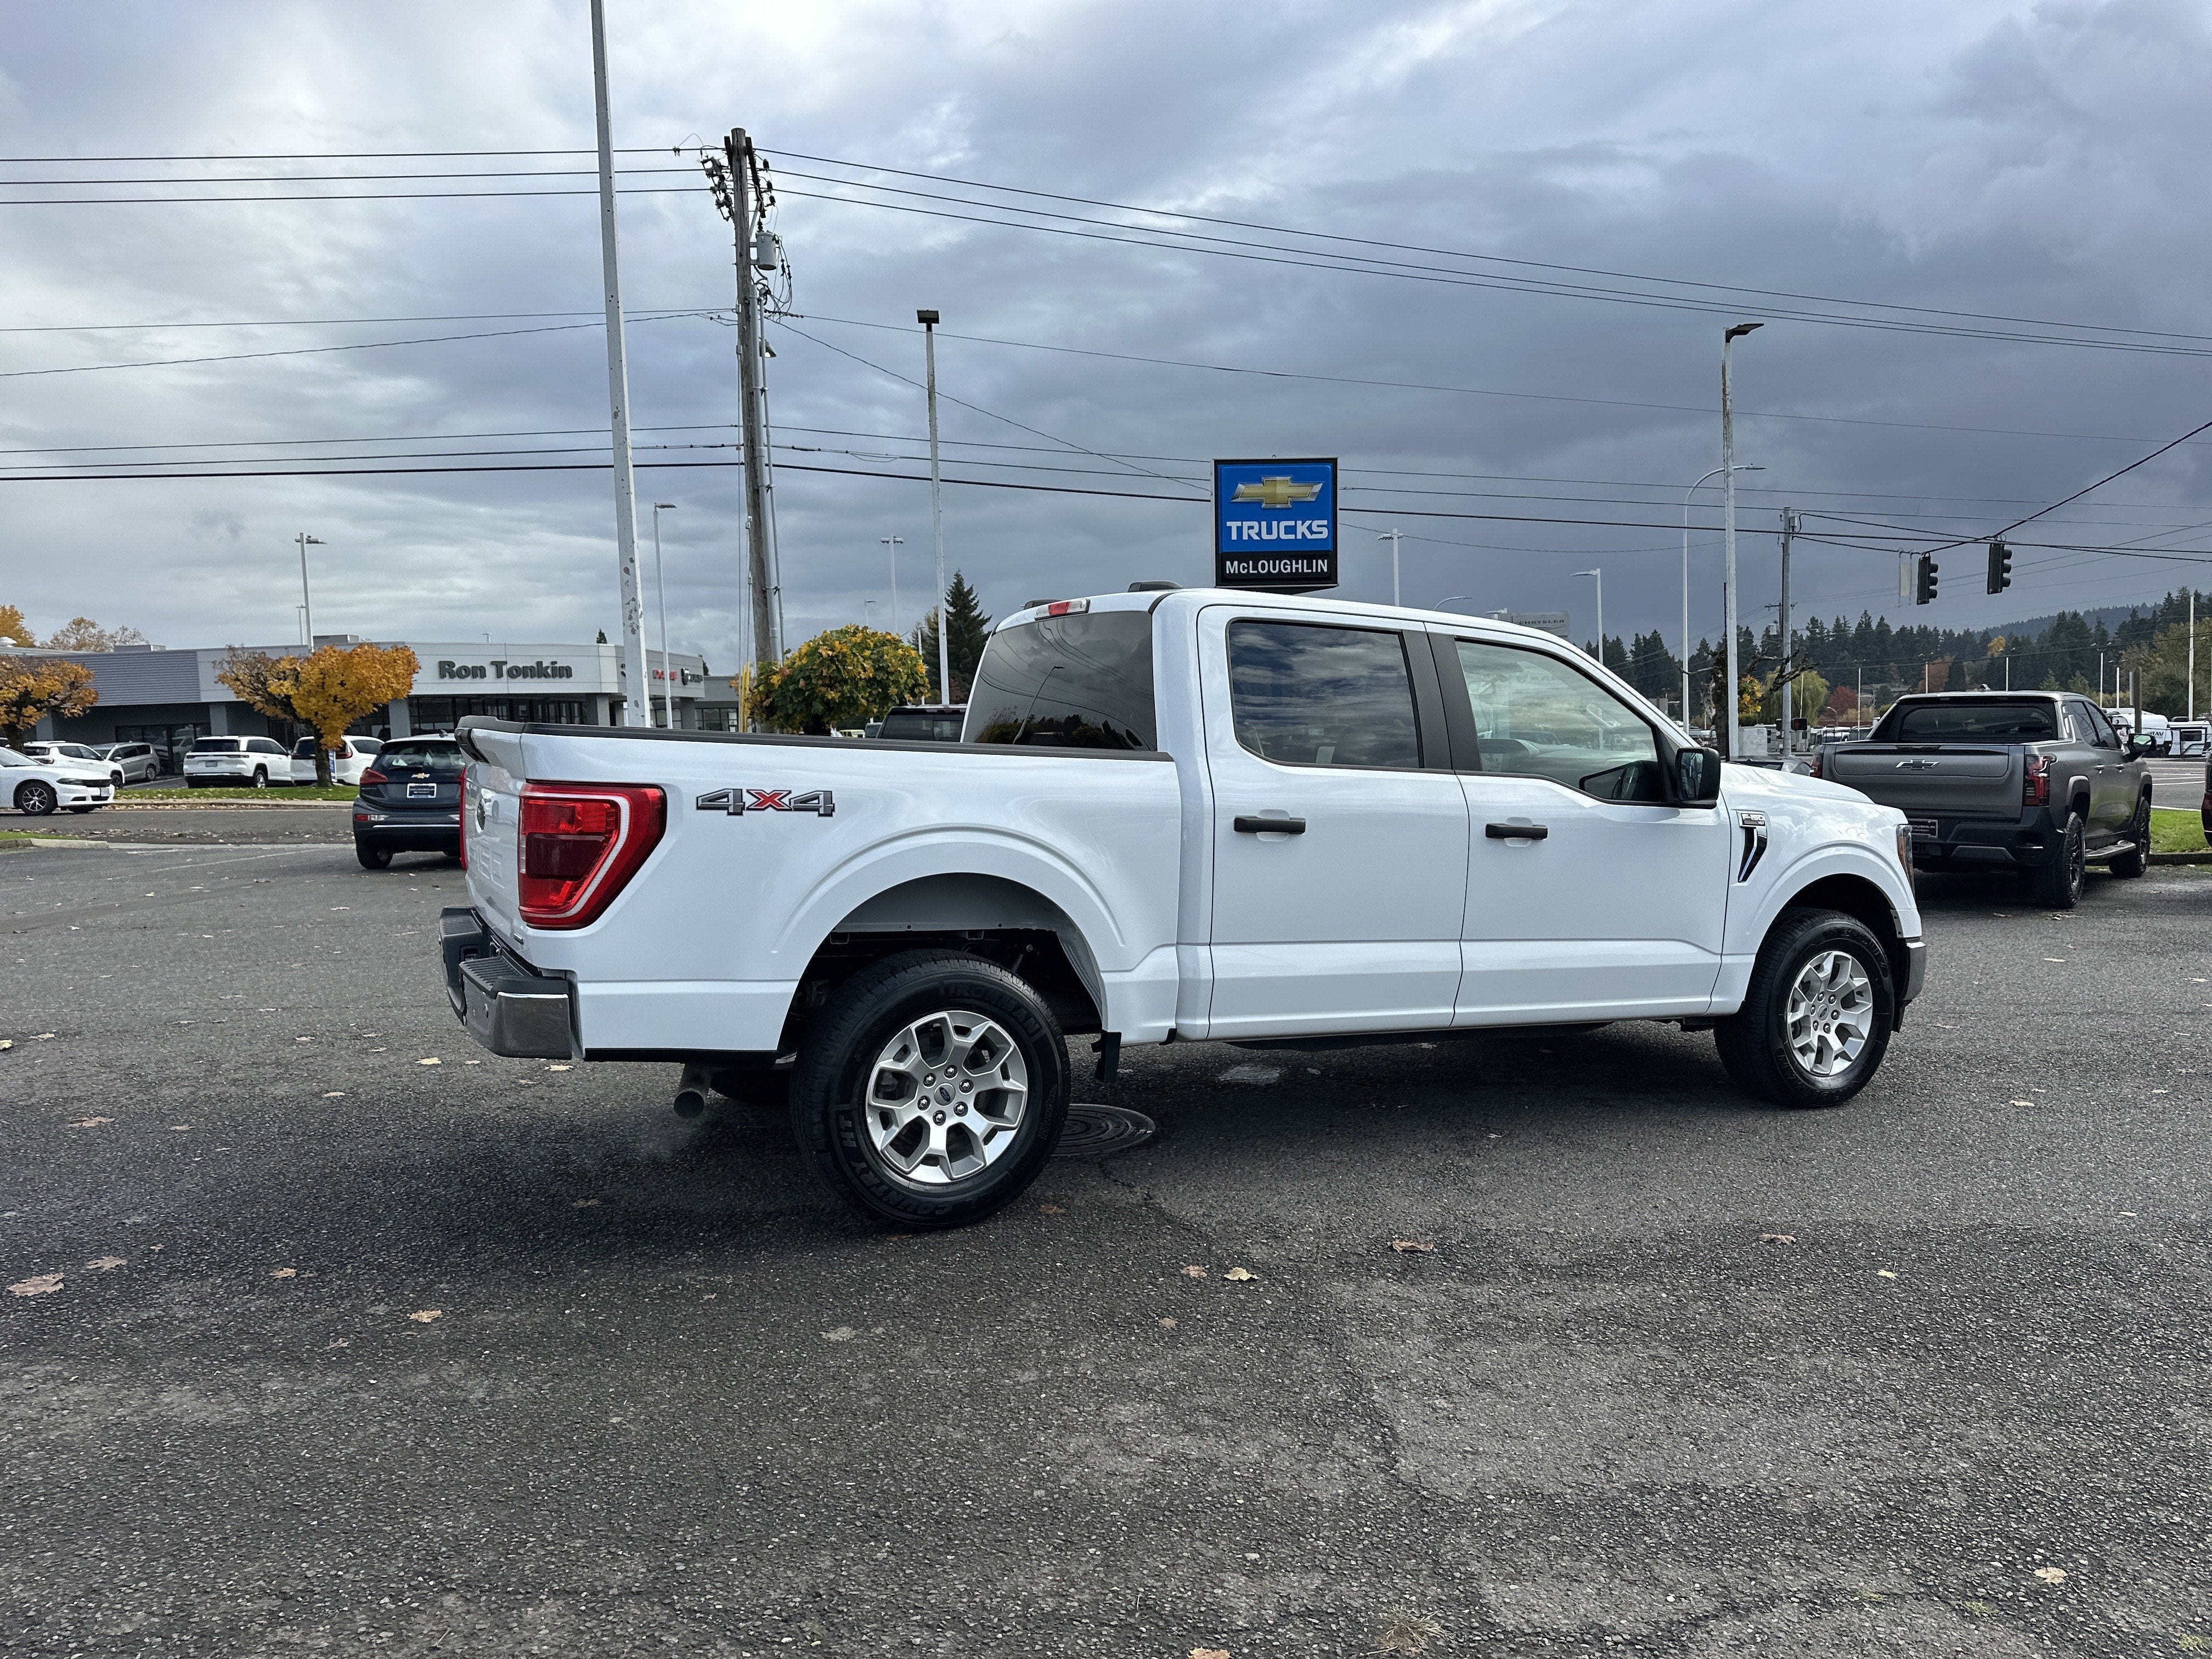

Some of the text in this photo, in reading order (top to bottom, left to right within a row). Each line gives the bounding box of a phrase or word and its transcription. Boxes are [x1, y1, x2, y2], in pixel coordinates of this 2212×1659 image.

[1226, 520, 1328, 540] TRUCKS
[1226, 559, 1328, 574] McLOUGHLIN
[438, 661, 572, 679] Ron Tonkin
[850, 1161, 953, 1215] COUNTRY
